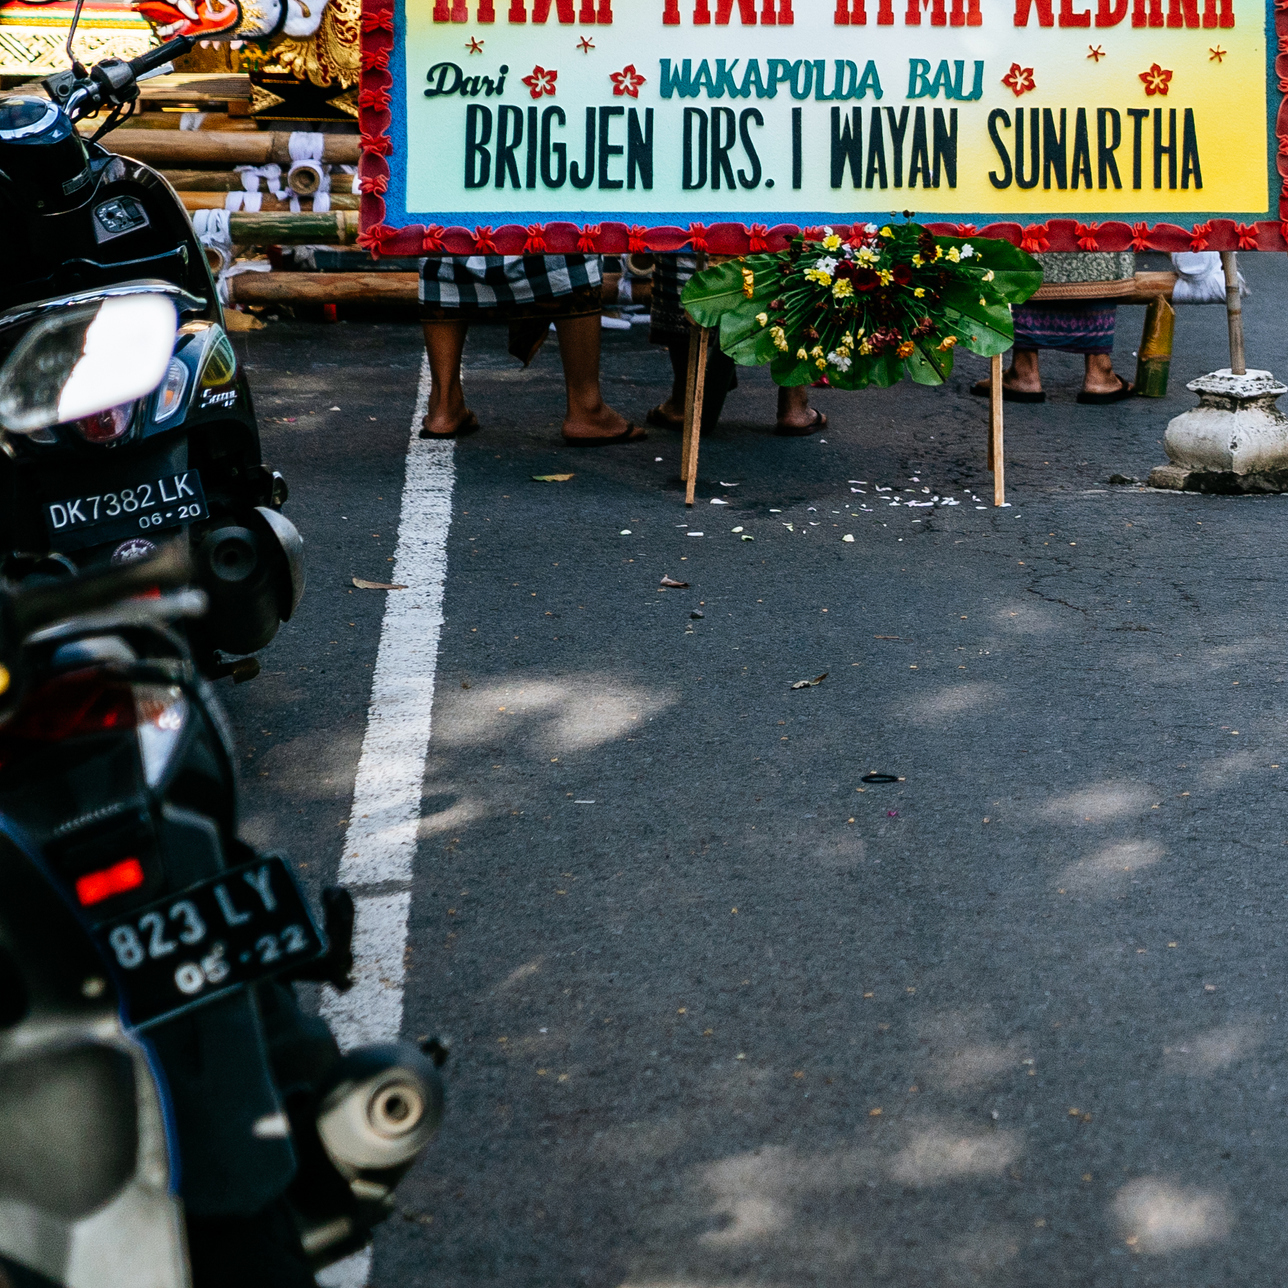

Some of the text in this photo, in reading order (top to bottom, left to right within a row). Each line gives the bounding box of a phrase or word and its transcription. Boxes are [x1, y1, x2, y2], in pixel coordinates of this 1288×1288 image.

[424, 58, 985, 102] Dari WAKAPOLDA BALI
[464, 104, 1204, 191] BRIGJEN DRS. I WAYAN SUNARTHA
[158, 473, 195, 503] LK
[108, 864, 278, 970] 823 LY
